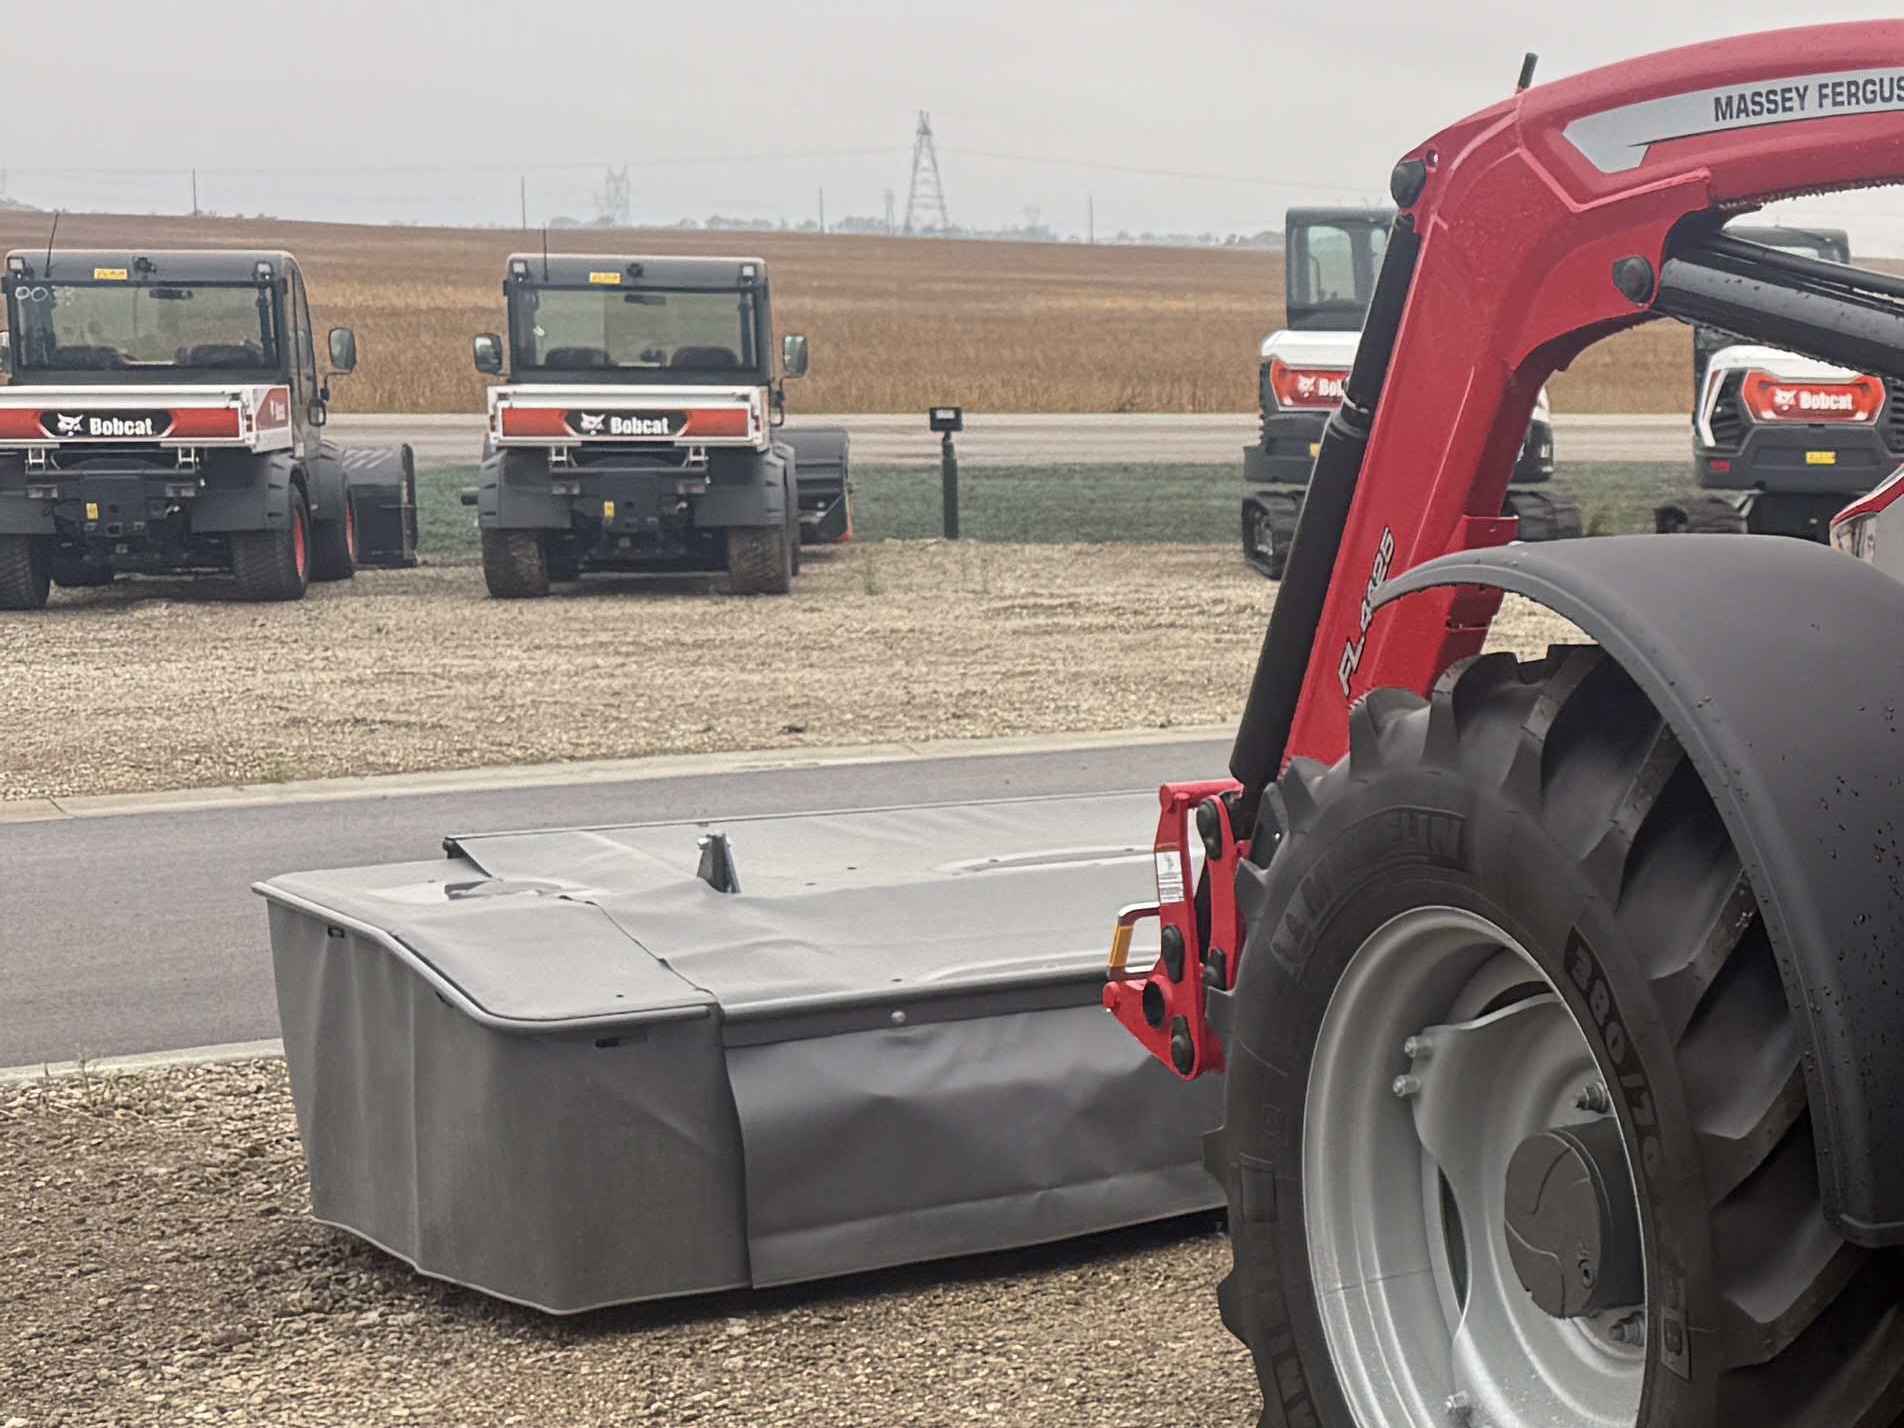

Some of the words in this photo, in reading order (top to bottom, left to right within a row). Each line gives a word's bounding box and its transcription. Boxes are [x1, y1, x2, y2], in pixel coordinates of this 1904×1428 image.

[1714, 84, 1809, 122] MASSEY
[1800, 390, 1853, 410] Bobcat
[88, 417, 153, 437] Bobcat
[610, 416, 669, 435] Bobcat
[1568, 941, 1664, 1179] 380/70
